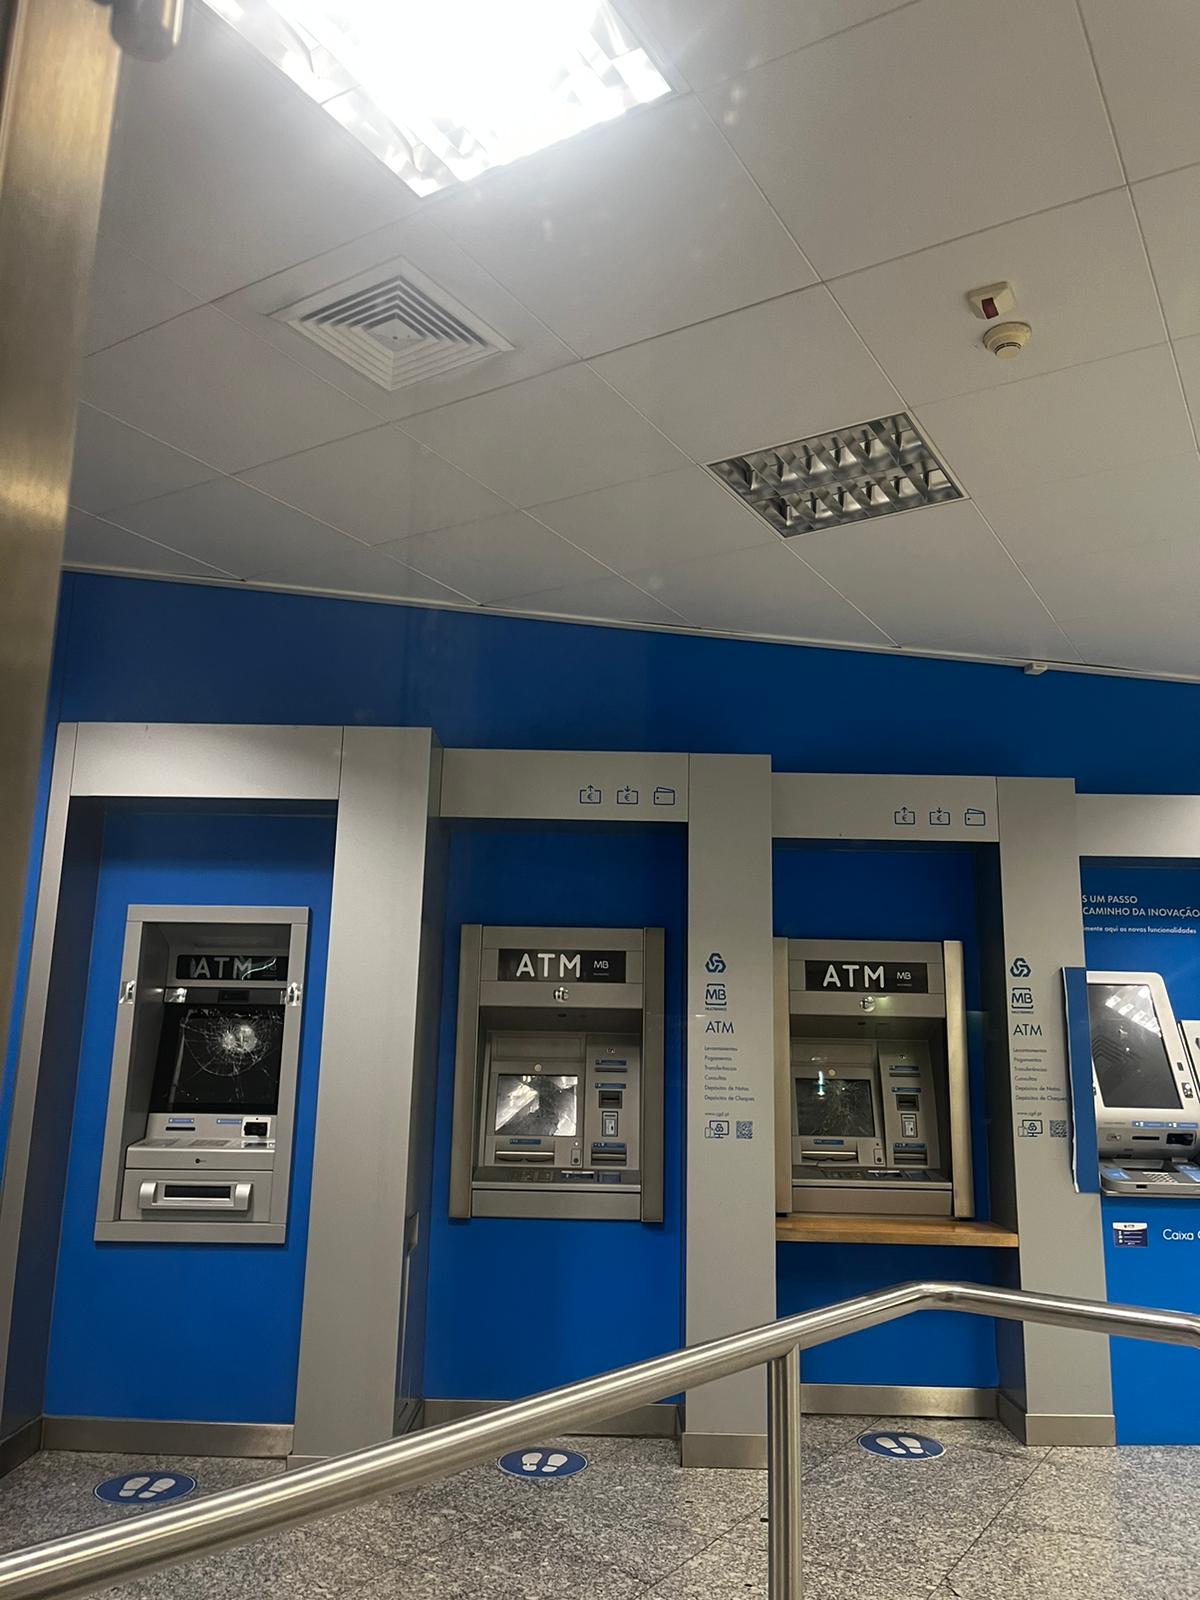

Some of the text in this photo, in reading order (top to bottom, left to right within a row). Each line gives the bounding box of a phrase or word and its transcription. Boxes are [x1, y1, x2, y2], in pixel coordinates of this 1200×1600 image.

[1090, 895, 1106, 903] UM
[1108, 895, 1138, 904] PASSO
[1083, 906, 1200, 919] CAMINHO DA INOVAÇÃO
[1105, 925, 1118, 933] aqui
[1148, 926, 1197, 934] funcionalidades
[193, 957, 252, 979] ATM
[516, 953, 581, 978] ATM
[593, 960, 609, 969] MB
[822, 964, 885, 989] ATM
[896, 972, 912, 980] MB
[705, 989, 727, 1000] MB
[1012, 992, 1033, 1004] MB
[705, 1020, 735, 1034] ATM
[1013, 1024, 1042, 1036] ATM
[1163, 1228, 1194, 1240] Caixa
